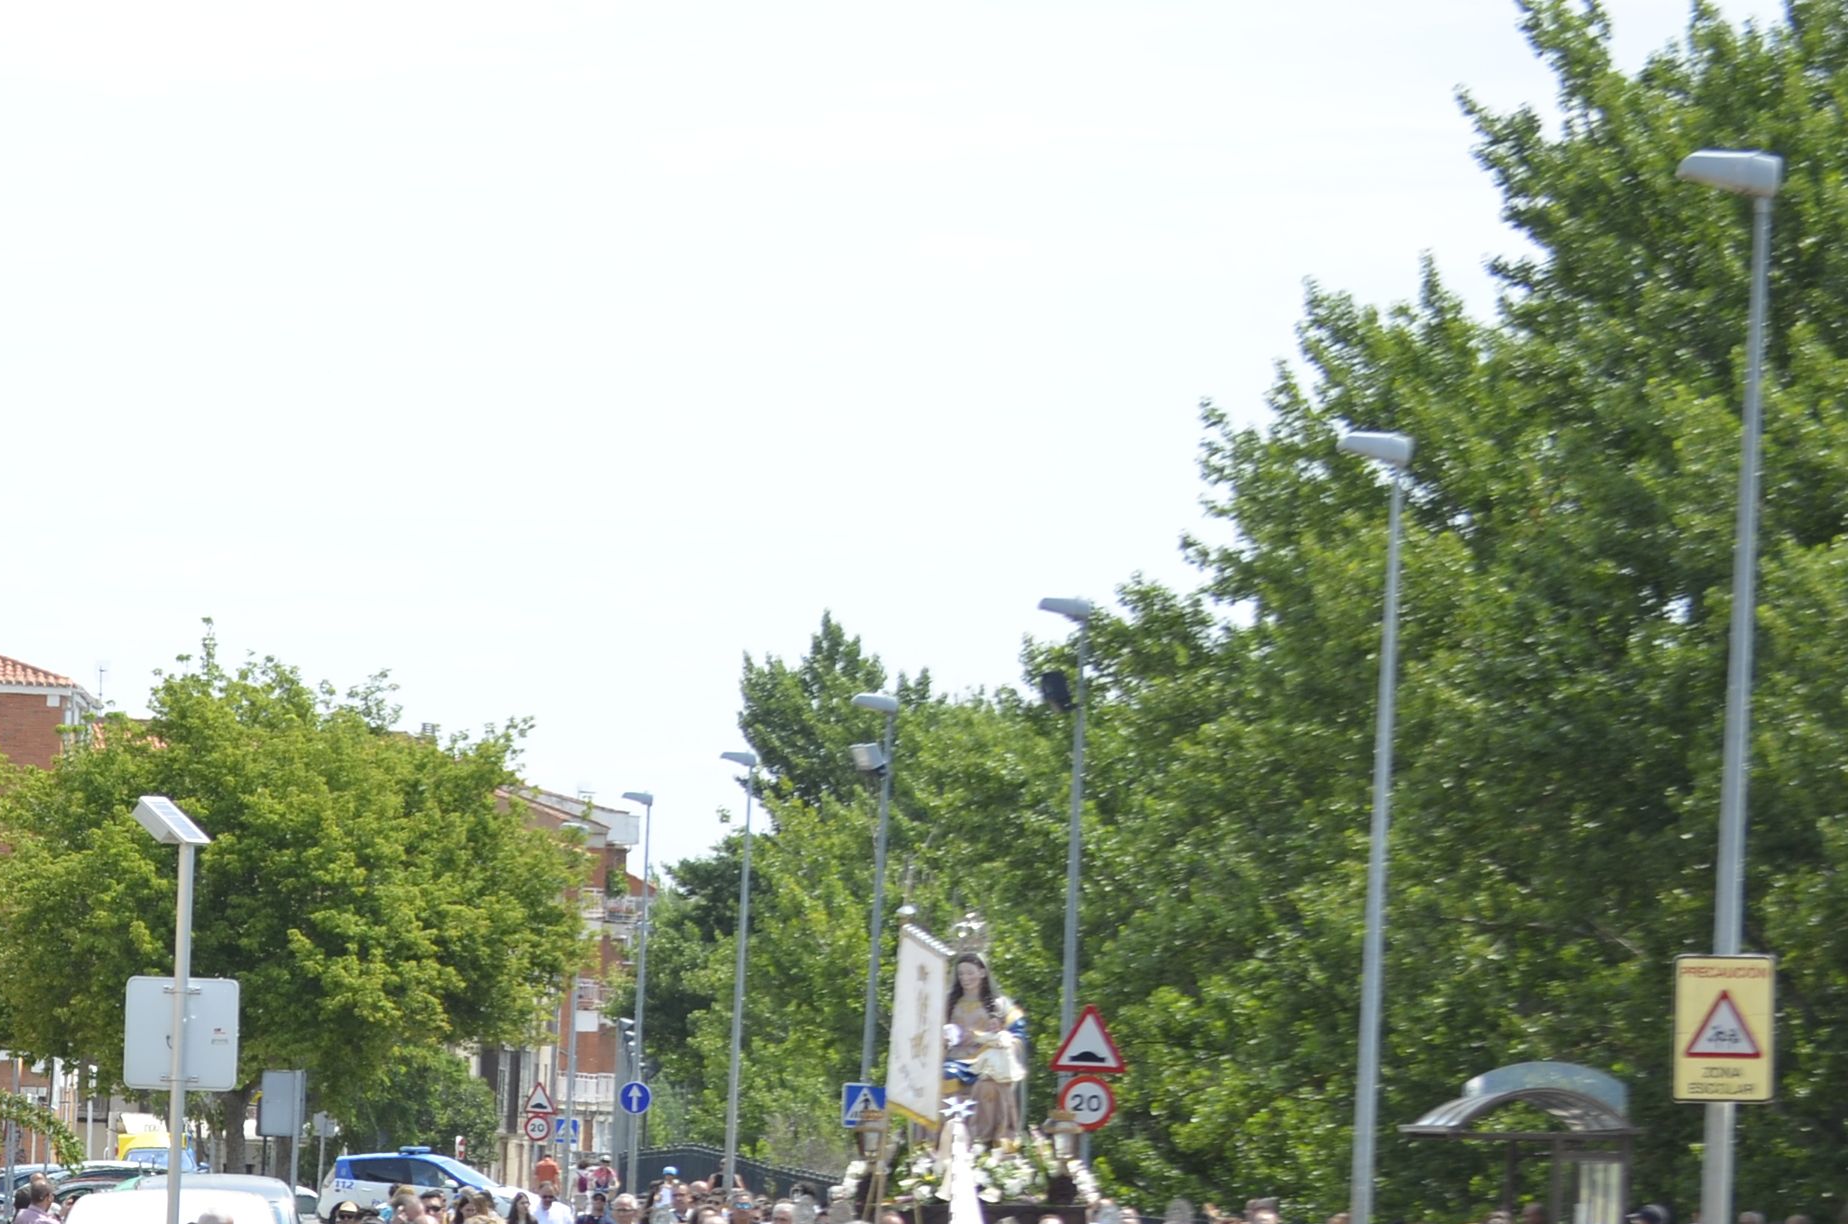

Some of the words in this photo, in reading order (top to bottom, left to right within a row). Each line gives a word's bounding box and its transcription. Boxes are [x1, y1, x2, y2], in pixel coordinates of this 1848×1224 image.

[1701, 1066, 1743, 1078] ZONA
[1687, 1082, 1755, 1095] ESCOLAR
[1071, 1094, 1101, 1112] 20
[530, 1123, 545, 1132] 20
[335, 1180, 355, 1190] 112
